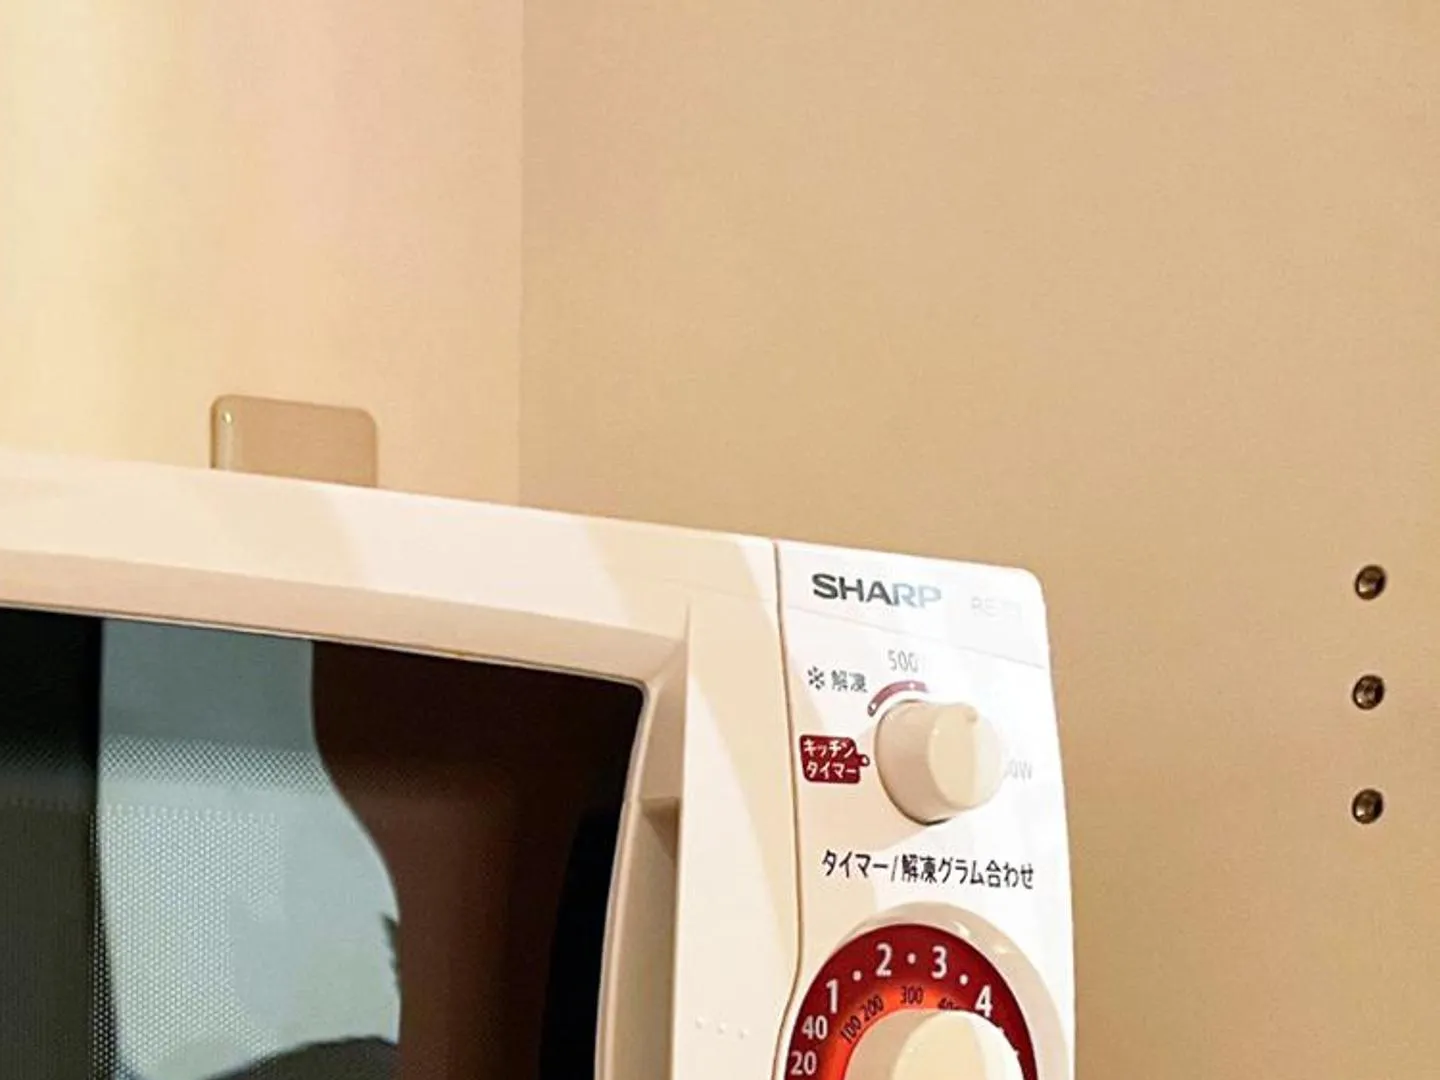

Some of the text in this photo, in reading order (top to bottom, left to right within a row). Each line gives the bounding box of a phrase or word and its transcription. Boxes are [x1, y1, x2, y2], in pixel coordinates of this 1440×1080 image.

[811, 573, 942, 609] SHARP
[887, 650, 919, 673] 500
[831, 669, 868, 693] 解凍
[803, 737, 854, 758] キッチン
[806, 759, 857, 780] タイマー
[822, 849, 1034, 890] タイマー/解凍グラム合わせ
[876, 943, 893, 978] 2
[931, 945, 948, 979] 3
[825, 979, 839, 1014] 1
[974, 984, 993, 1018] 4
[801, 1015, 828, 1041] 40
[839, 1015, 862, 1044] 100
[860, 993, 885, 1022] 200
[899, 985, 924, 1006] 300
[790, 1051, 817, 1076] 20
